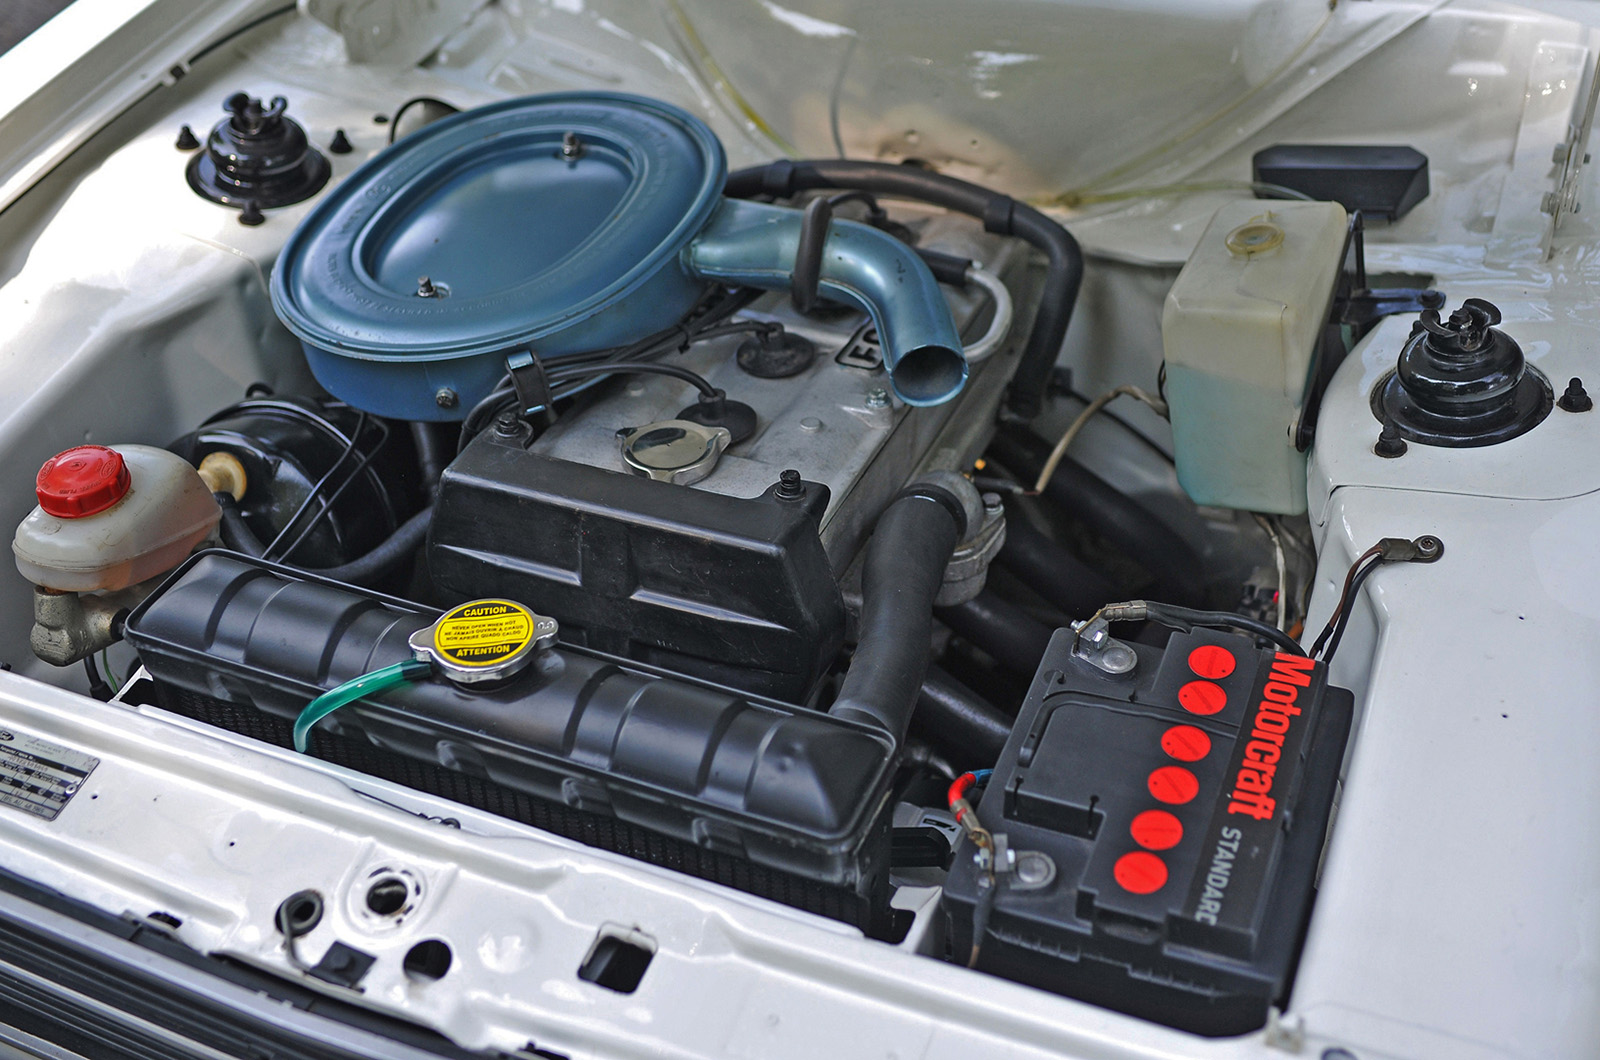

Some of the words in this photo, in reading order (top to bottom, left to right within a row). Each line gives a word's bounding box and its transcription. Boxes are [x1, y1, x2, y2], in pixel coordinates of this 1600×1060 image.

[464, 606, 507, 617] CAUTION
[456, 646, 510, 657] ATTENTION
[1227, 651, 1316, 820] Motorcraft
